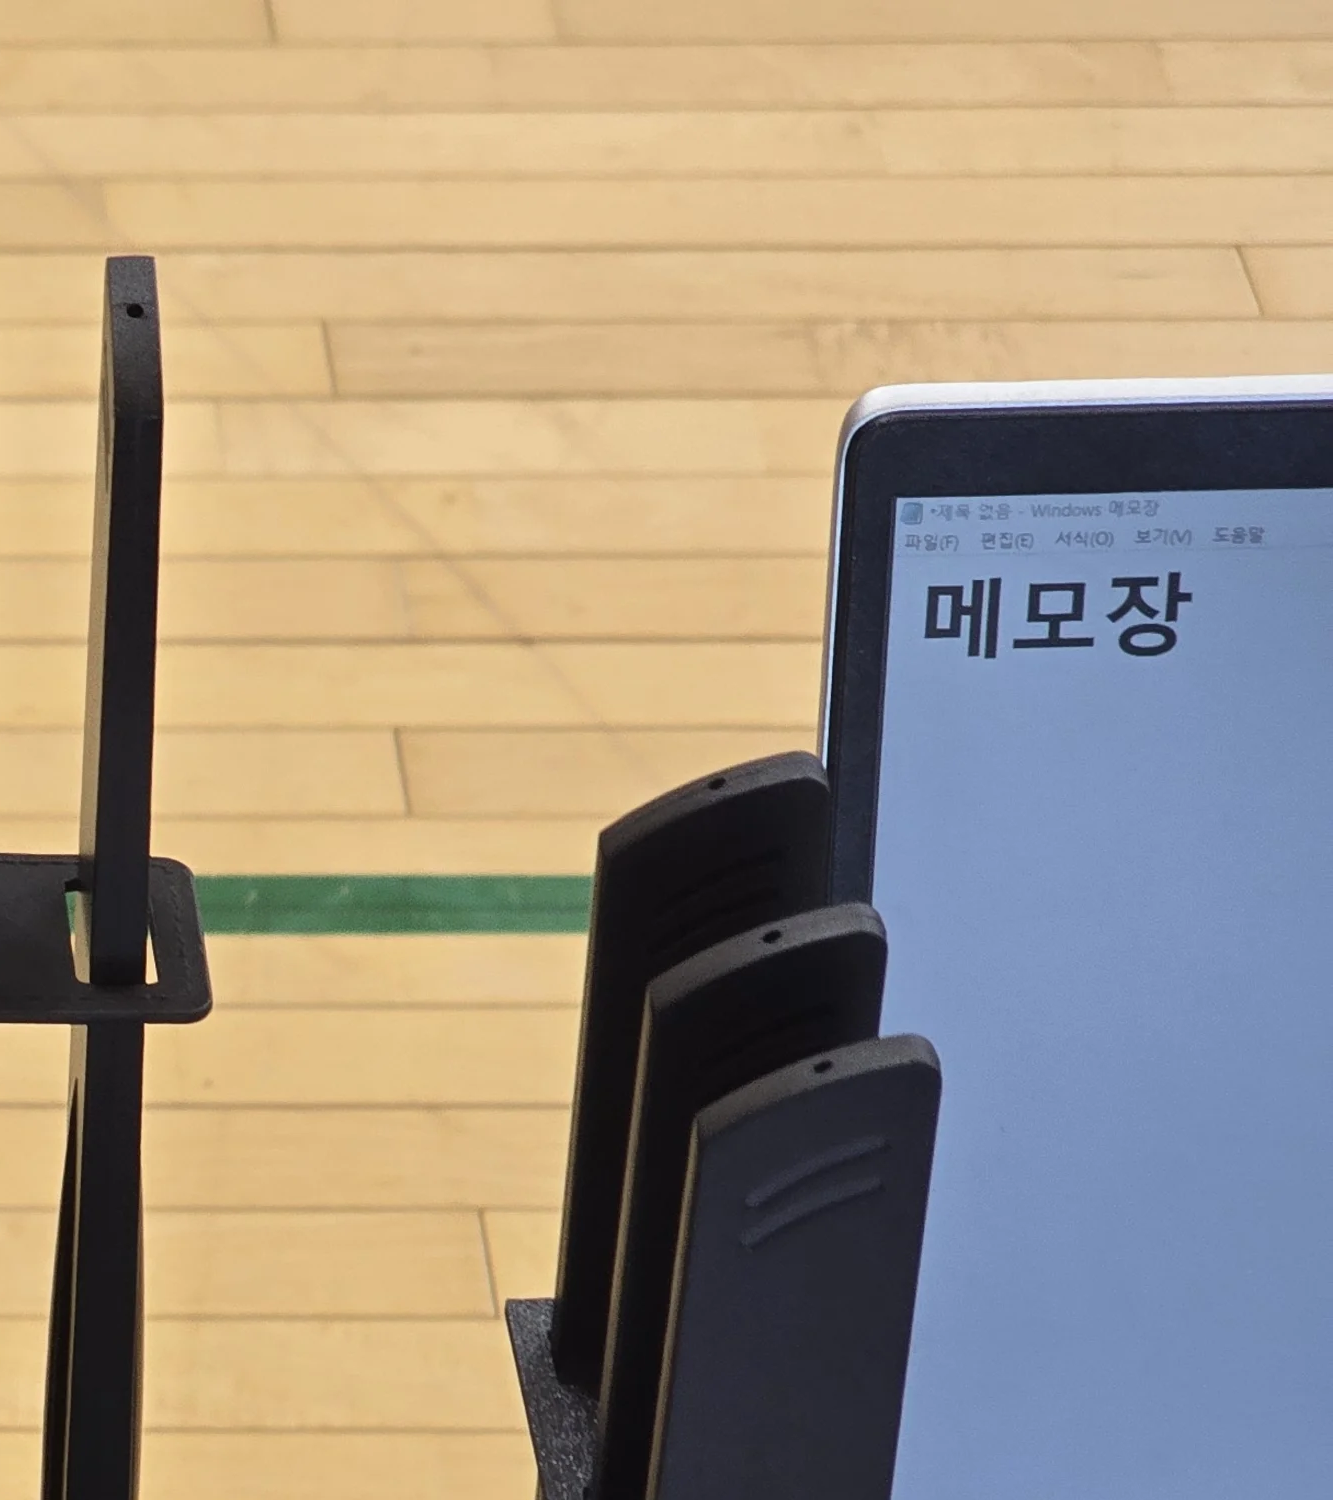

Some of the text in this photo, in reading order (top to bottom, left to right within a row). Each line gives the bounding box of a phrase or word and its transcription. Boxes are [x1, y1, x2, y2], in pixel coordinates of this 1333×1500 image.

[1031, 502, 1101, 518] Windows
[1108, 500, 1160, 517] 메모장
[904, 533, 959, 551] 파일(F)
[981, 532, 1034, 549] 편집(E)
[1055, 531, 1114, 548] 서식(O)
[1134, 528, 1192, 546] 보기(V)
[1213, 526, 1265, 546] 도움말
[924, 571, 1193, 659] 메모장
